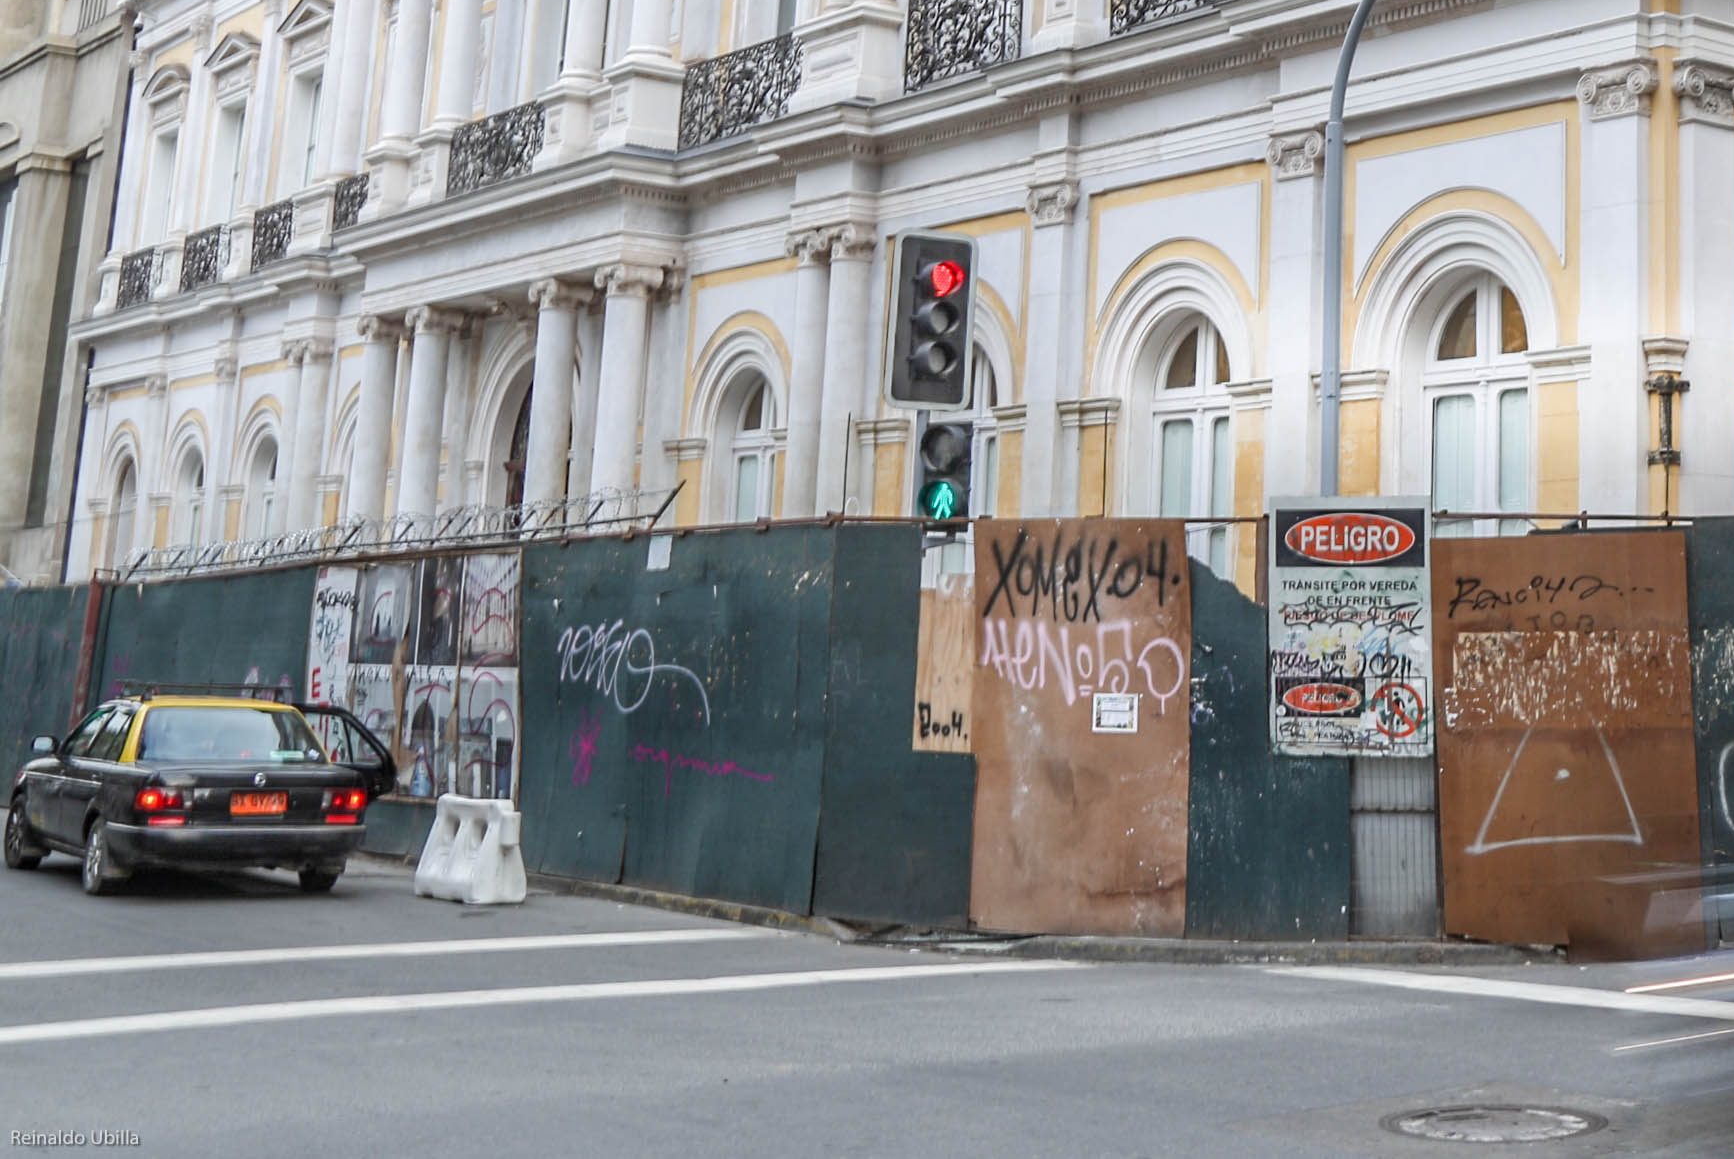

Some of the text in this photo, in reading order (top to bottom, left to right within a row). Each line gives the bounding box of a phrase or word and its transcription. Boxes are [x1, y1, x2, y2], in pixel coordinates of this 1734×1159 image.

[1300, 525, 1400, 552] PELIGRO
[1341, 580, 1366, 591] POR
[1369, 580, 1417, 591] VEREDA
[1326, 595, 1342, 606] EN
[1345, 595, 1391, 606] FRENTE
